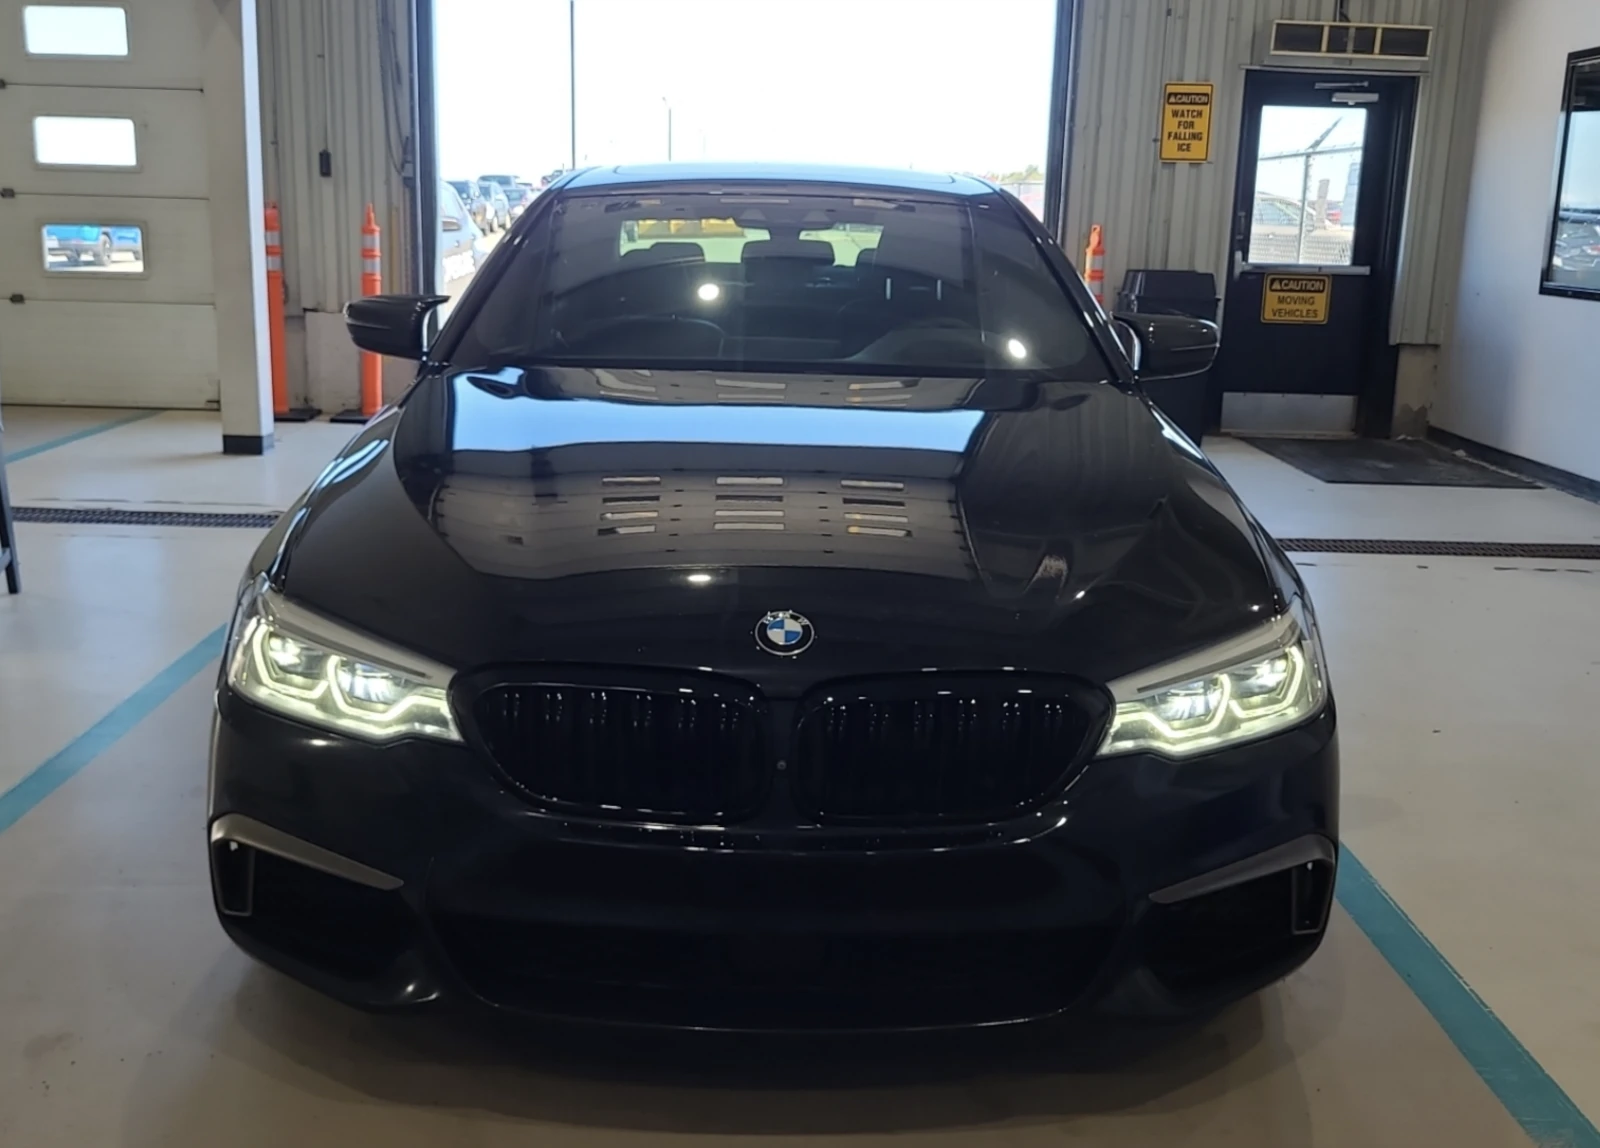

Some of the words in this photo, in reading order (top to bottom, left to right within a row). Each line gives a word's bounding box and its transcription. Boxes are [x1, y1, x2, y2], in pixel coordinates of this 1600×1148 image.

[1176, 95, 1208, 103] CAUTION
[1171, 109, 1203, 118] WATCH
[1177, 121, 1195, 130] FOR
[1167, 131, 1203, 141] FALLING
[1177, 143, 1192, 152] ICE
[1281, 280, 1324, 291] CAUTION
[1277, 295, 1315, 306] MOVING
[1271, 308, 1318, 319] VEHICLES
